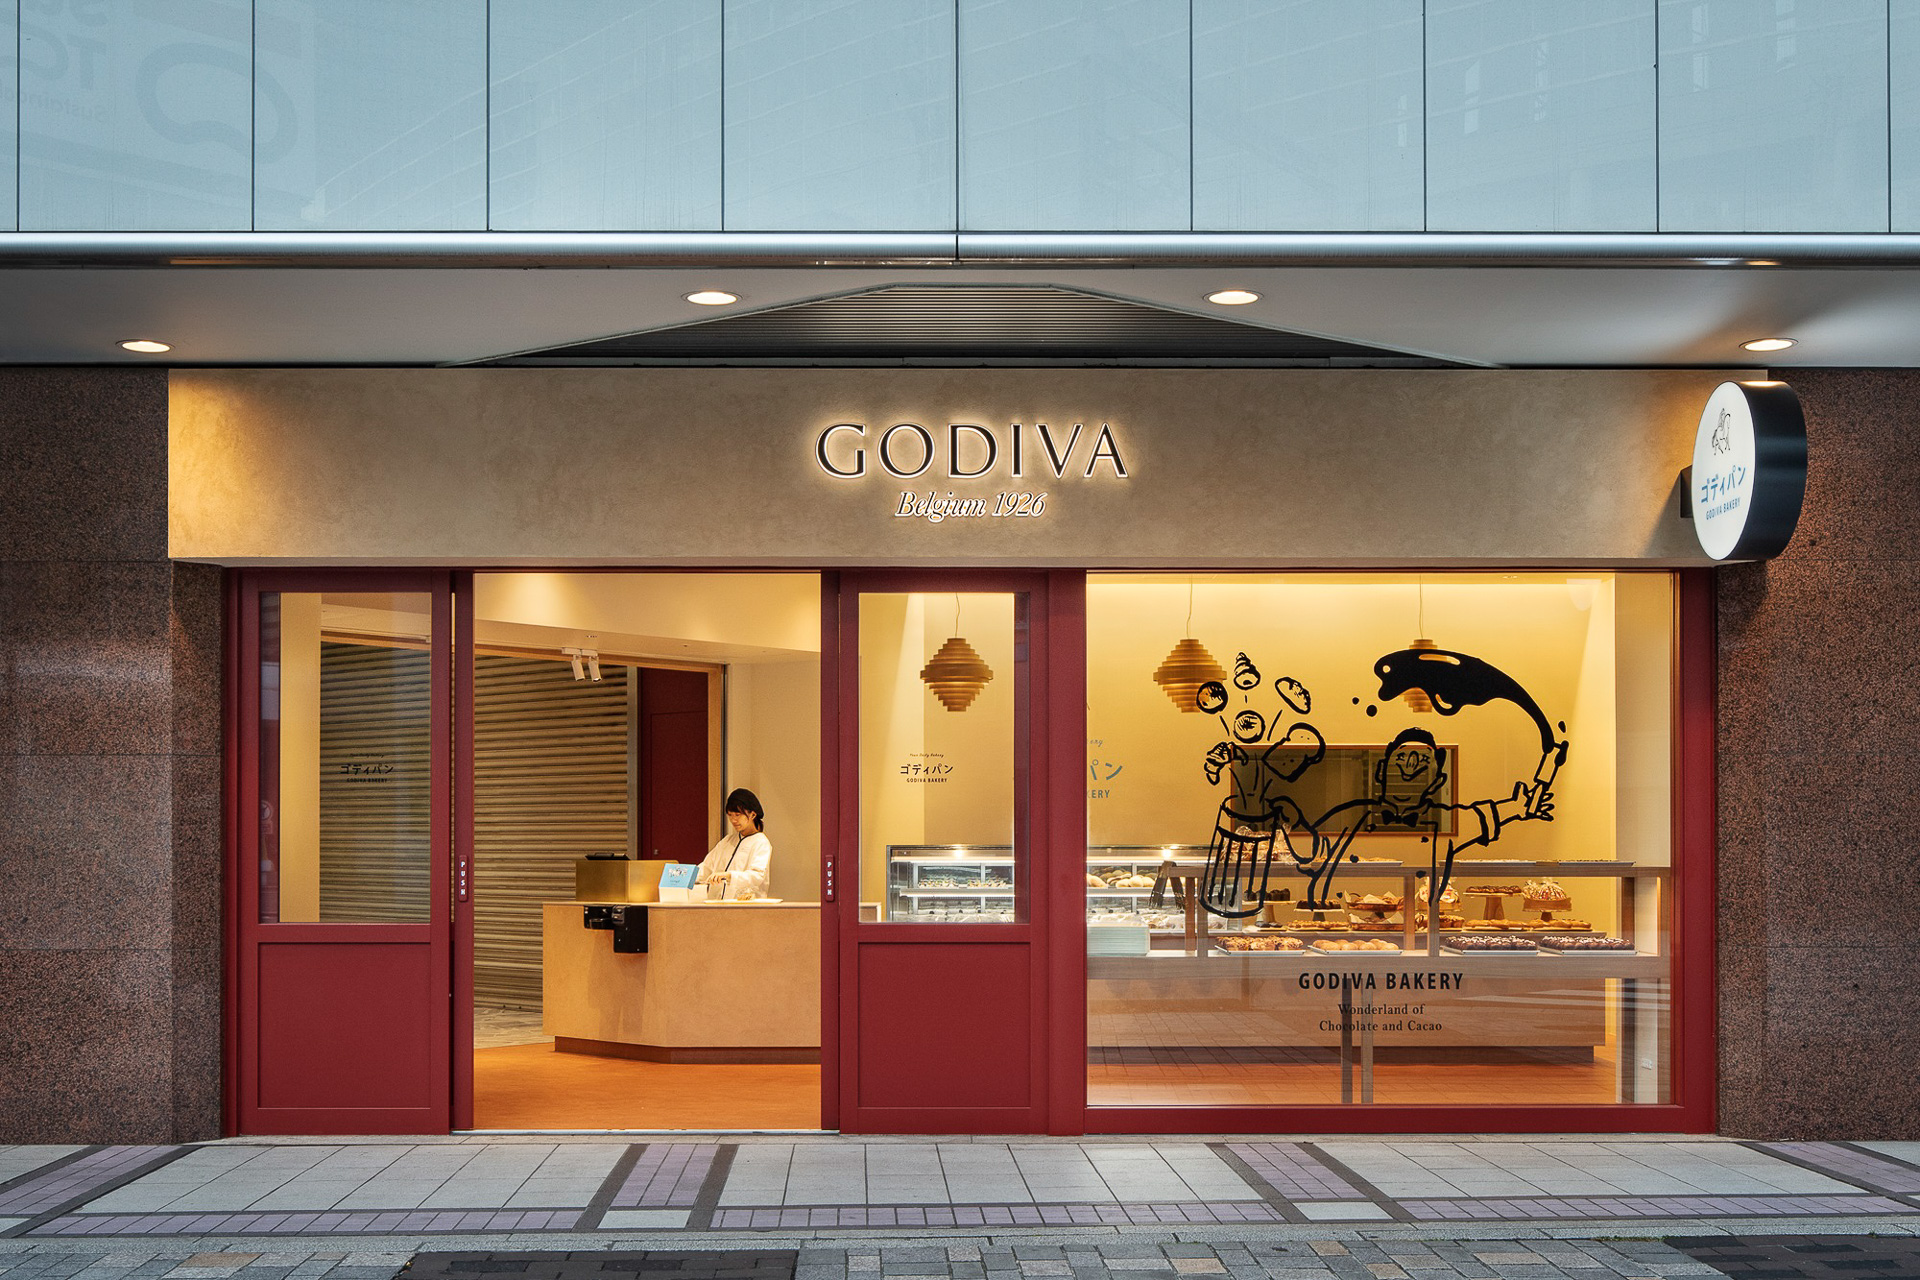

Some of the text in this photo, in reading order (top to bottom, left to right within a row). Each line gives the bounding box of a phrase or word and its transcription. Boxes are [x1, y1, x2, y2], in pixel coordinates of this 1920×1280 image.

[815, 422, 1128, 479] GODIVA
[1701, 465, 1746, 504] ゴディパン
[895, 490, 1048, 523] Belgium 1926
[340, 762, 394, 776] ゴディパン
[900, 762, 954, 776] ゴディパン
[1298, 972, 1464, 990] GODIVA BAKERY
[1338, 1003, 1426, 1015] Wonderland of
[1319, 1020, 1443, 1032] Chocolate and Cacao
